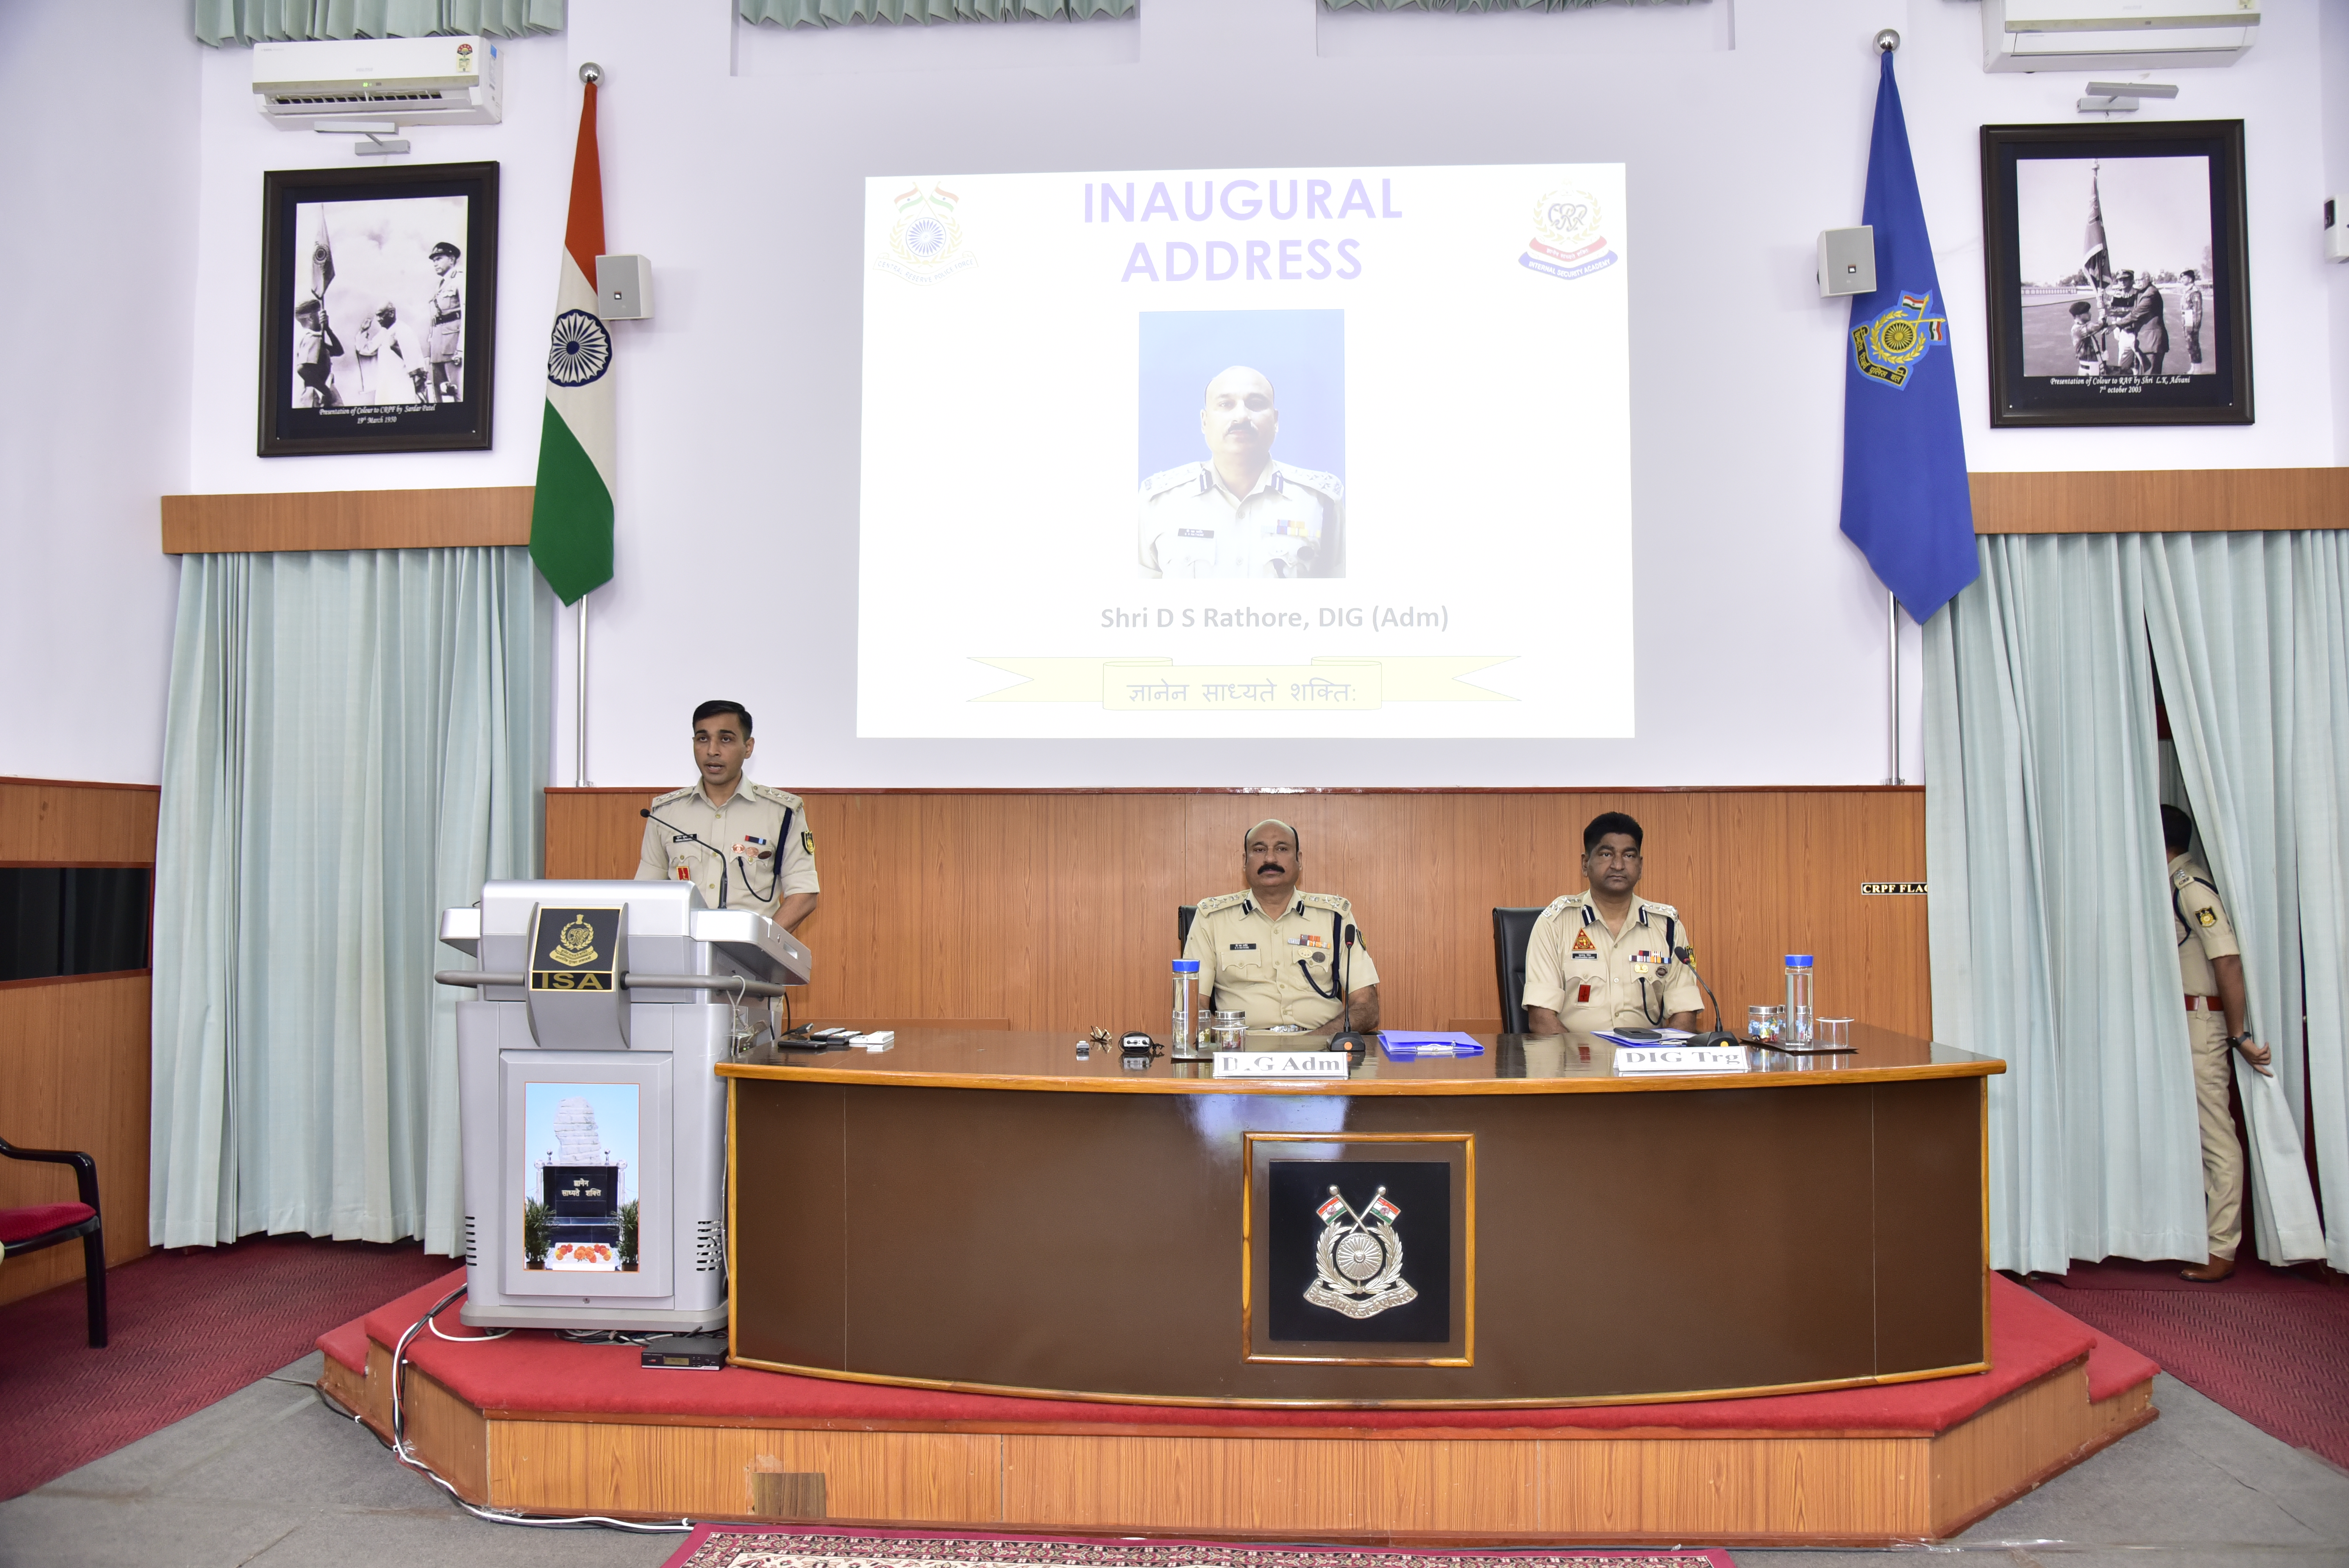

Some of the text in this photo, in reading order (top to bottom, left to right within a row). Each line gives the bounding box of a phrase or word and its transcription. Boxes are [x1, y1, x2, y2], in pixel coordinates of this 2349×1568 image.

[1085, 178, 1402, 223] INAUGURAL
[1121, 239, 1362, 282] ADDRESS
[1528, 258, 1611, 277] INTERNAL SECURITY ACADEMY
[878, 259, 973, 282] CENTRAL RESERVE POLICE FORCE
[2085, 377, 2092, 387] of
[2092, 376, 2111, 385] Colour
[2134, 376, 2140, 386] by
[2141, 376, 2153, 385] Shri
[2169, 376, 2190, 385] Advani
[2108, 385, 2127, 393] october
[350, 407, 357, 416] of
[396, 406, 403, 414] by
[1101, 606, 1448, 632] Shri D S Rathore, DIG (Adm)
[1126, 678, 1190, 702] ज्ञानेन
[1202, 678, 1277, 702] साध्यते
[1863, 884, 1896, 893] CRPF
[542, 973, 603, 989] ISA
[1222, 1057, 1340, 1071] DG Adm
[1625, 1052, 1740, 1065] DIG Trg
[561, 1188, 601, 1196] साध्यते शक्ति
